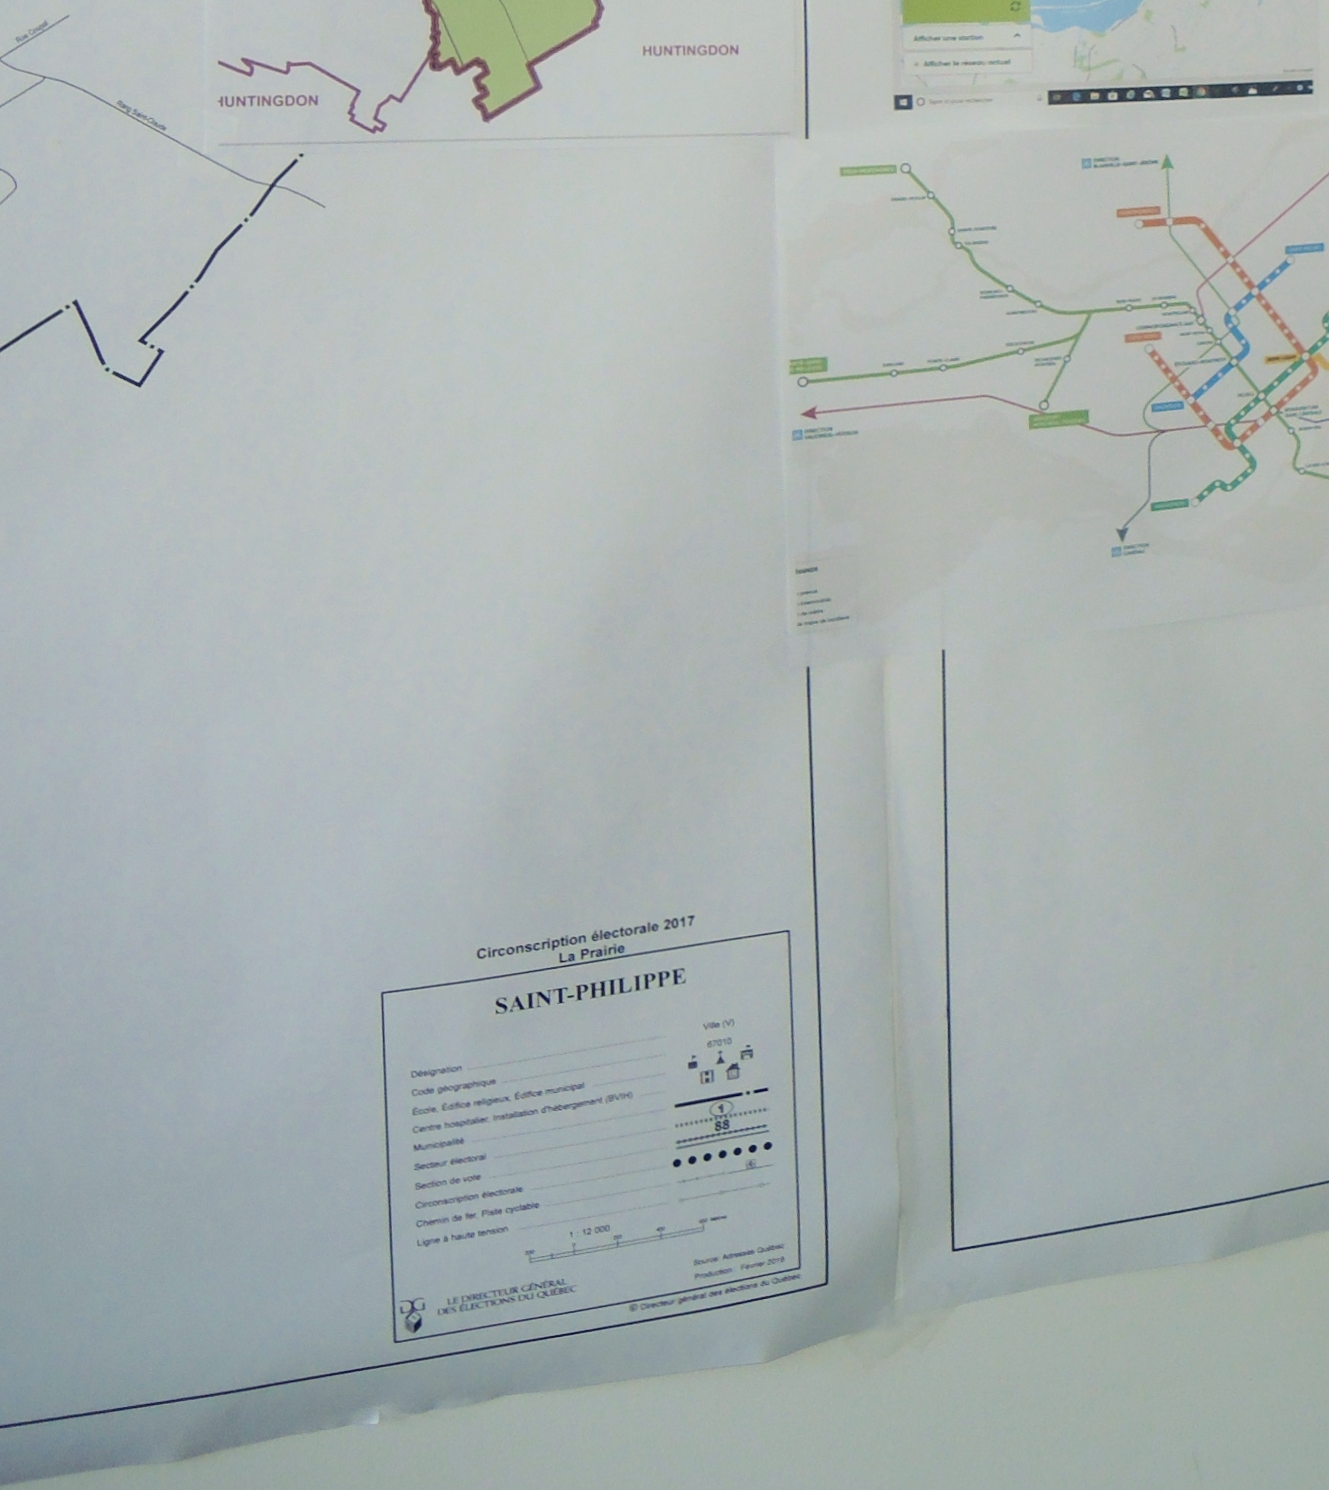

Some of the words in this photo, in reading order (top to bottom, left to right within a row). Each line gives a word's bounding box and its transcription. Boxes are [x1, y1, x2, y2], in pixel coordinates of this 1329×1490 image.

[641, 44, 739, 57] HUNTINGDON
[476, 934, 587, 960] Circonscription
[591, 923, 659, 942] électorale
[663, 915, 695, 930] 2017
[559, 952, 575, 963] La
[581, 943, 626, 960] Prairie
[495, 968, 686, 1015] SAINT-PHILIPPE
[411, 1065, 462, 1079] Désignation
[412, 1087, 435, 1097] Code
[437, 1078, 496, 1095] géographique
[414, 1138, 465, 1152] Municipalité
[414, 1160, 447, 1171] Secteur
[450, 1154, 486, 1165] électoral
[415, 1179, 447, 1190] Section
[463, 1174, 481, 1183] vote
[415, 1193, 479, 1209] Circonscription
[482, 1186, 523, 1199] électorale
[416, 1216, 449, 1228] Chemin
[452, 1214, 462, 1222] de
[417, 1236, 441, 1247] Ligne
[451, 1231, 475, 1241] haute
[478, 1226, 508, 1237] tension
[461, 1287, 518, 1304] DIRECTEUR
[521, 1279, 568, 1292] GÉNÉRAL
